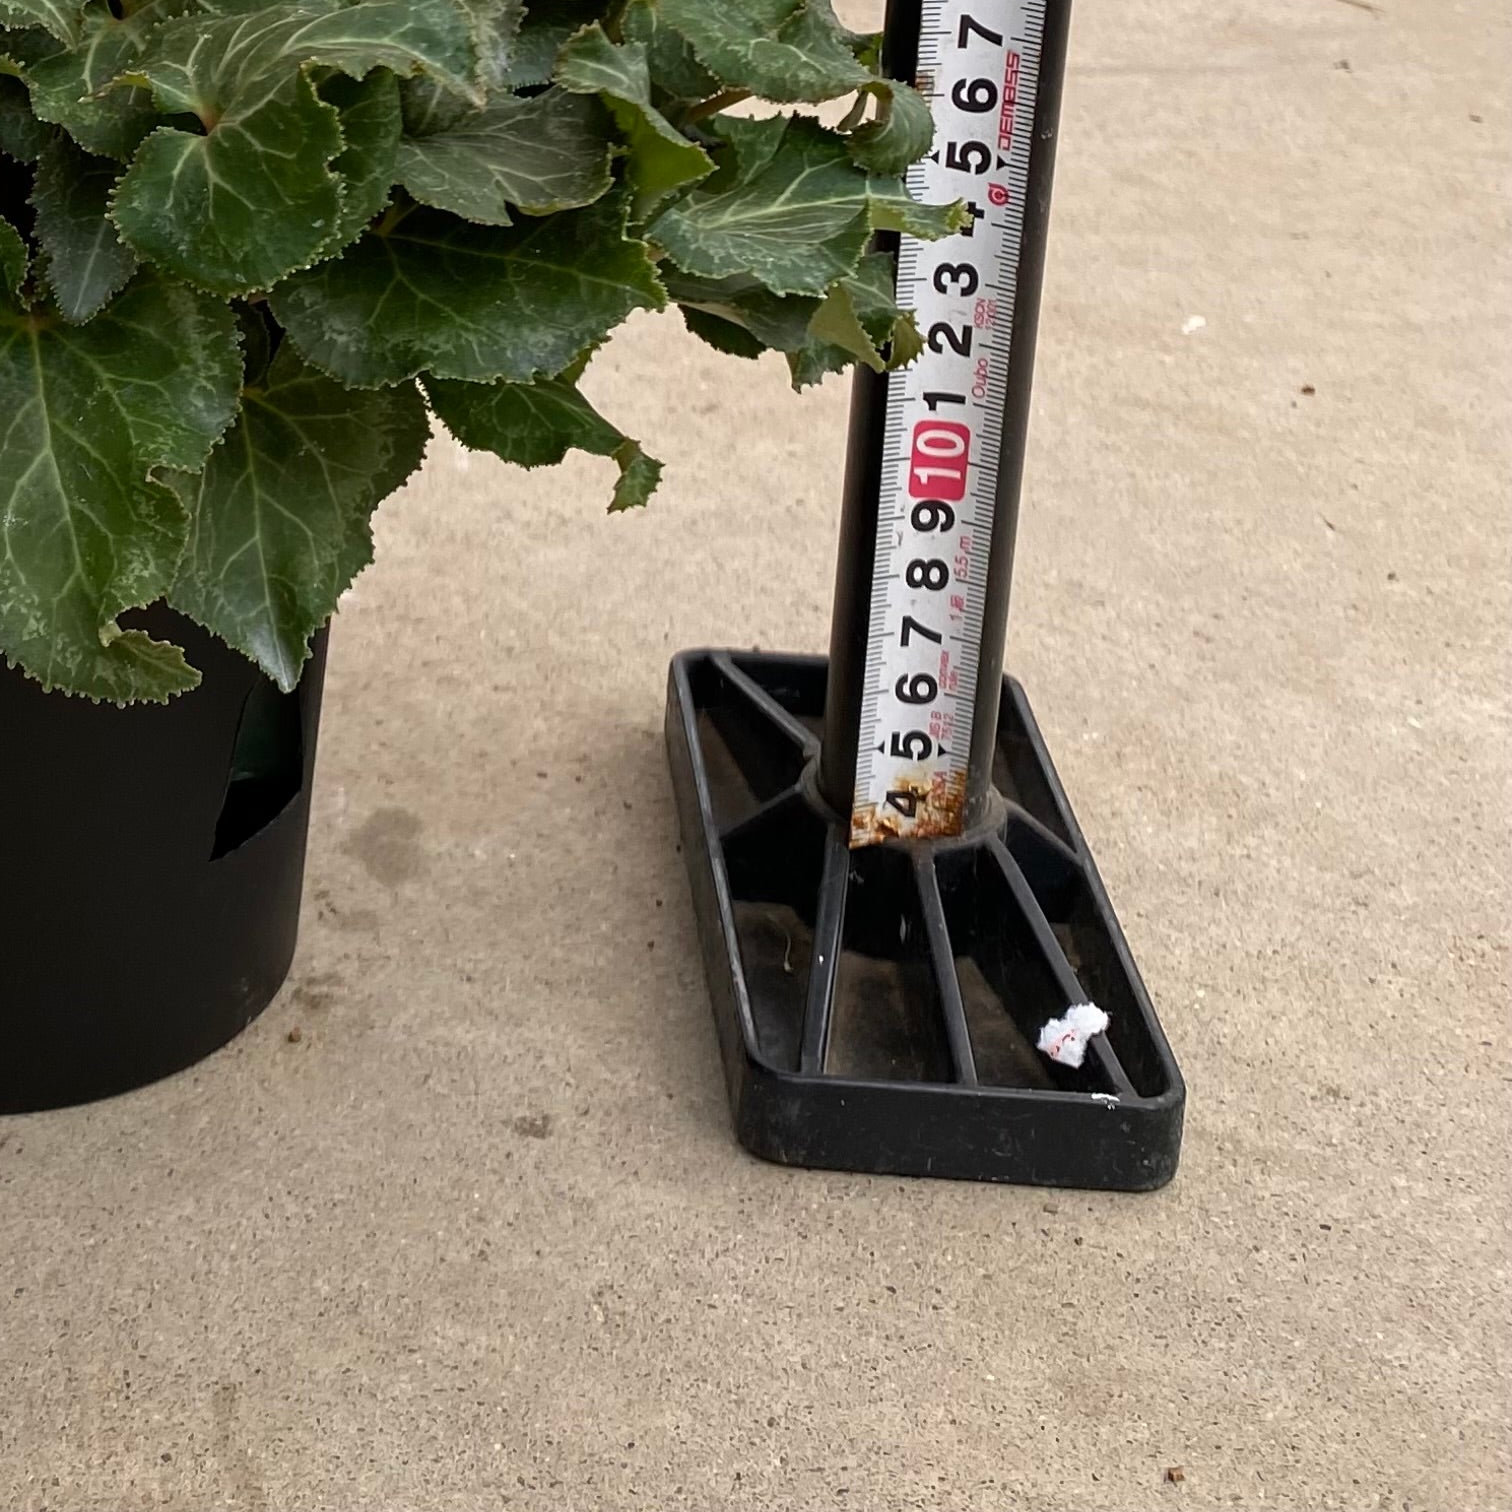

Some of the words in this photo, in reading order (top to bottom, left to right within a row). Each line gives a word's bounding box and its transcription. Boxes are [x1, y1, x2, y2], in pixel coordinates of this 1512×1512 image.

[957, 14, 1003, 49] 7
[951, 78, 998, 114] 6
[945, 140, 992, 176] 5
[933, 262, 979, 297] 3
[927, 322, 973, 358] 2
[922, 392, 967, 411] 1
[913, 428, 965, 486] 10
[910, 499, 955, 533] 9
[905, 558, 950, 592] 8
[900, 615, 942, 647] 7
[895, 673, 938, 705] 6
[890, 730, 933, 762] 5
